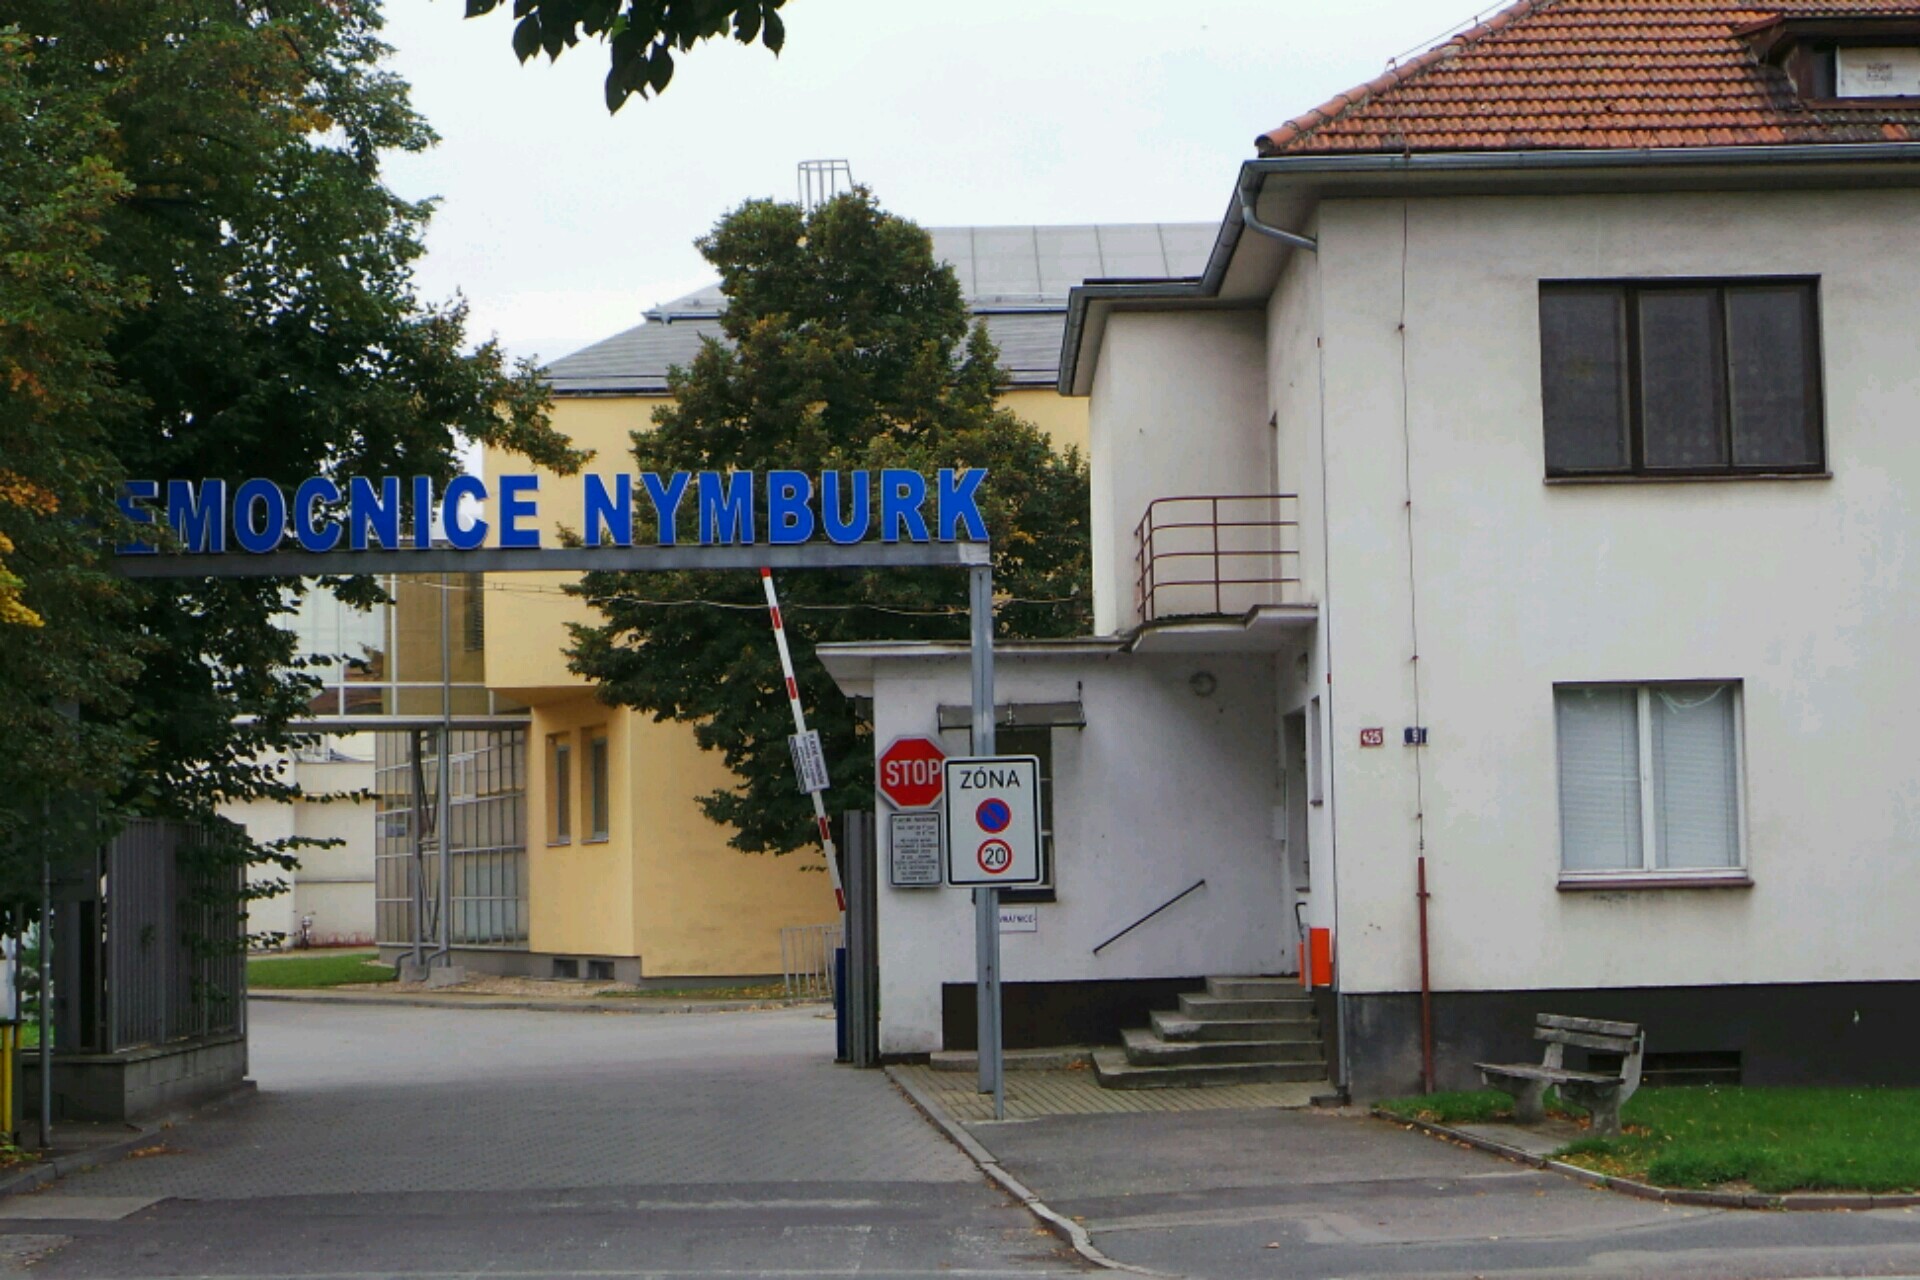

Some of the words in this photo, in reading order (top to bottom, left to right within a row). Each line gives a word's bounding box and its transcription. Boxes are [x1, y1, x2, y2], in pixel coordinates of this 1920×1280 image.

[100, 475, 541, 554] EMOCNICE
[583, 468, 990, 547] NYMBURK
[885, 759, 941, 787] STOP
[959, 766, 1021, 790] ZÓNA
[984, 848, 1006, 865] 20
